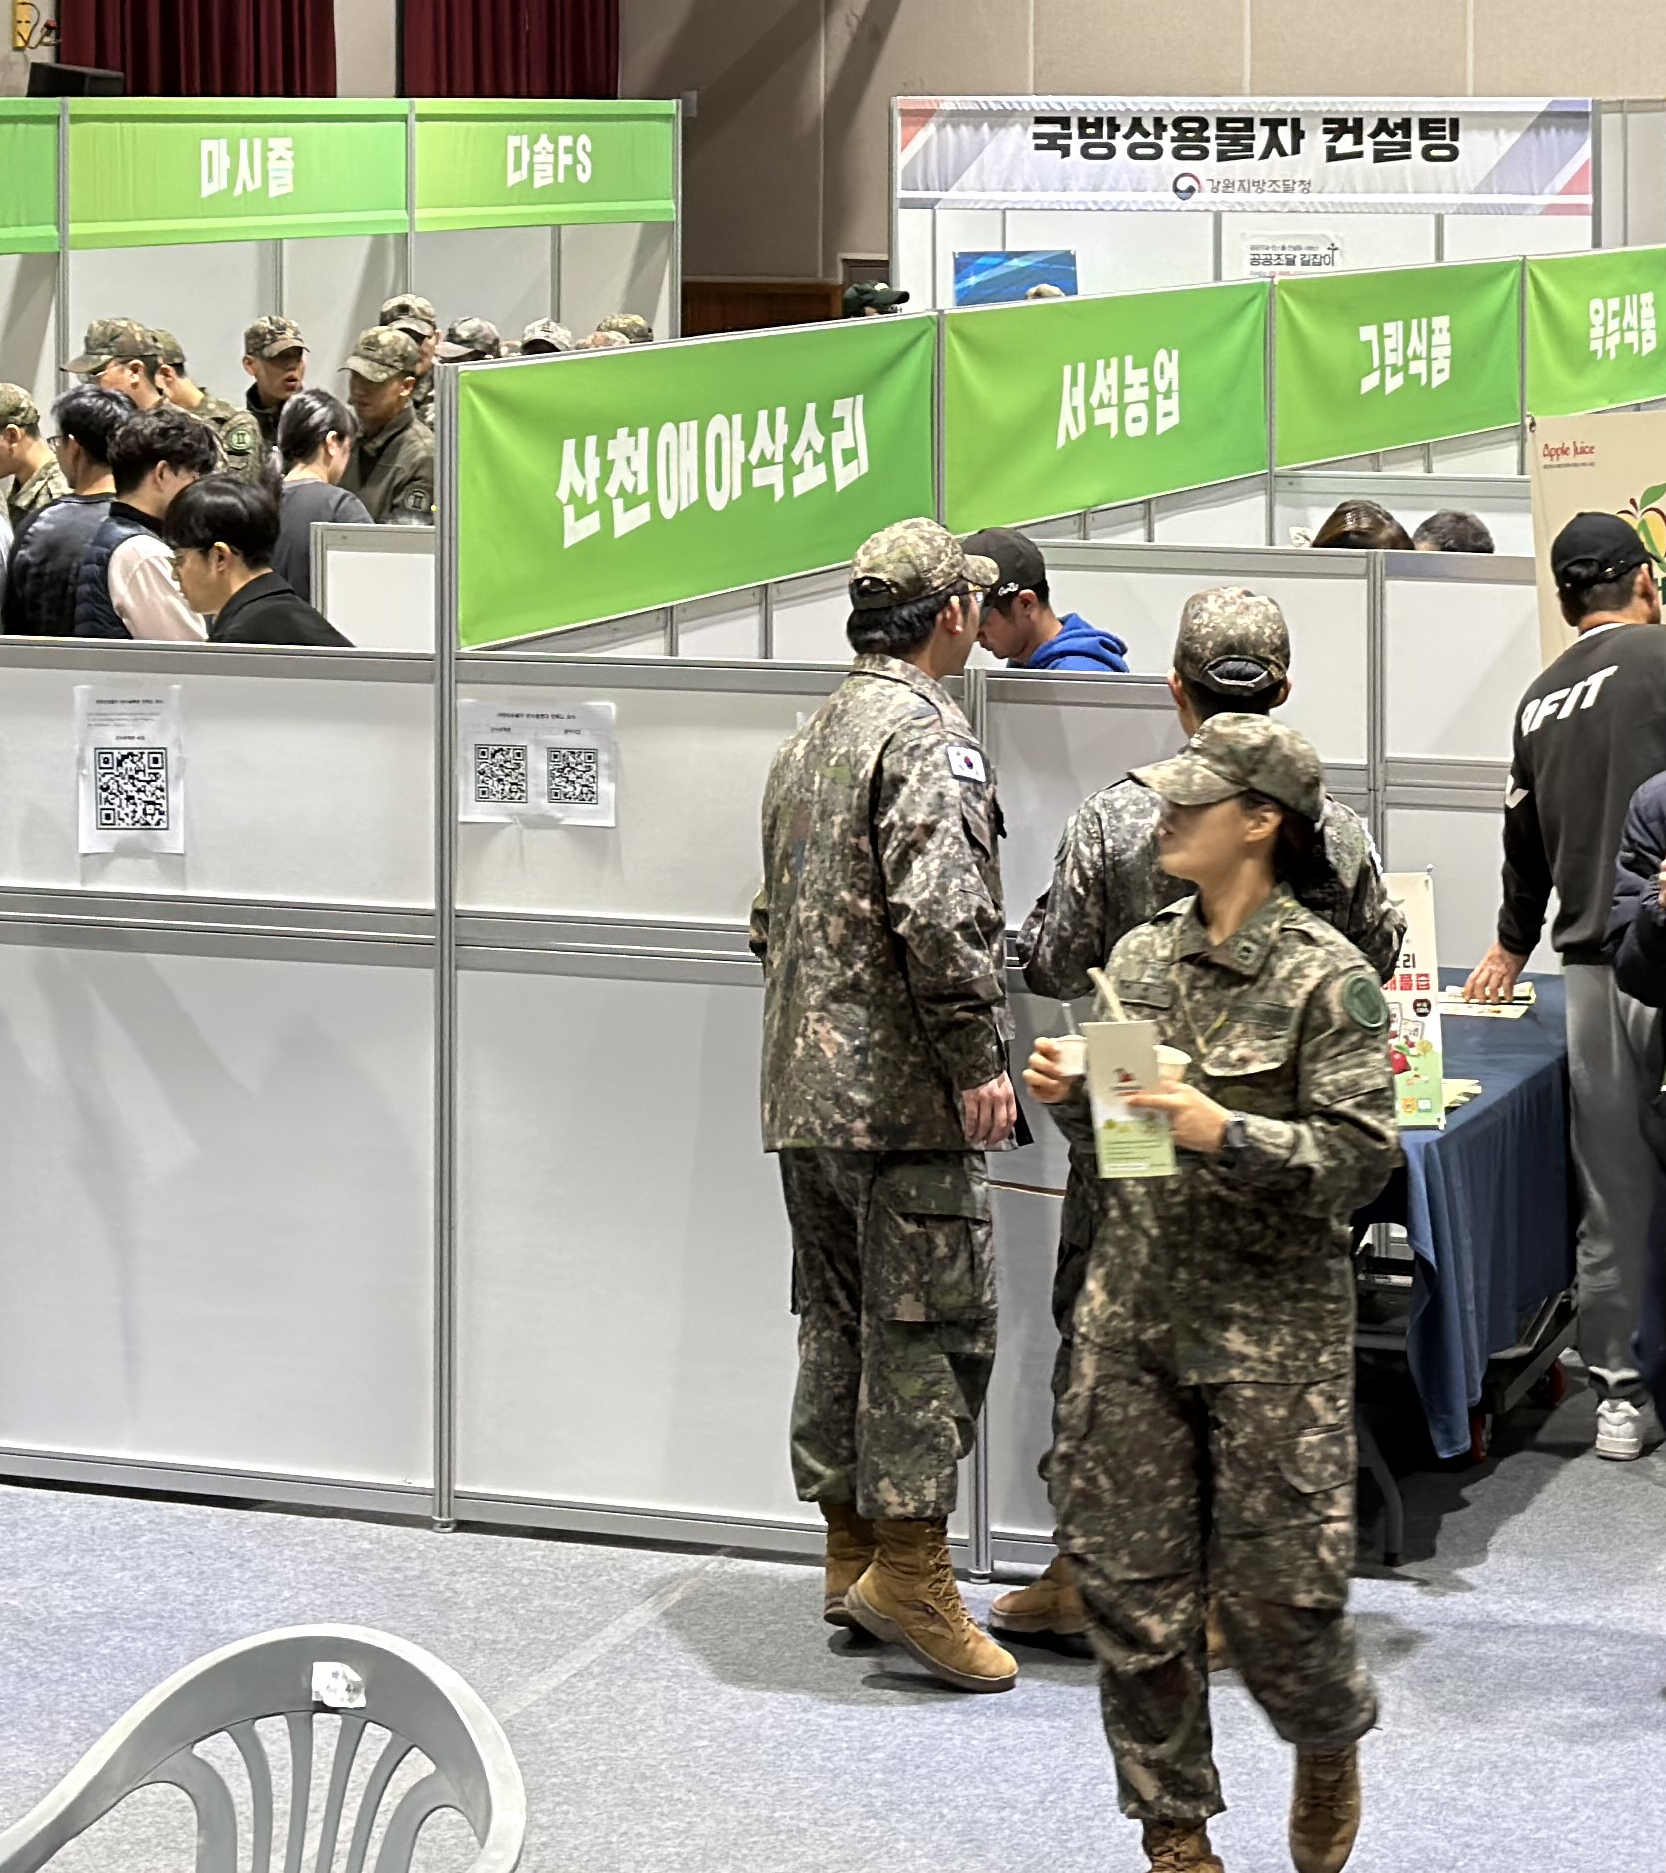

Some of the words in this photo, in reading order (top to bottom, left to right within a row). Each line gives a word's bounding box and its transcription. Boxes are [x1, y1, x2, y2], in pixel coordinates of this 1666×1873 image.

[506, 133, 592, 189] 다솔FS
[1032, 115, 1306, 163] 국방상용물자
[1322, 116, 1460, 164] 컨설팅
[1359, 315, 1452, 396] 그린식품
[1589, 291, 1657, 360] 옥두식품
[1056, 348, 1180, 449] 서석농업
[555, 394, 869, 549] 산천애아삭소리
